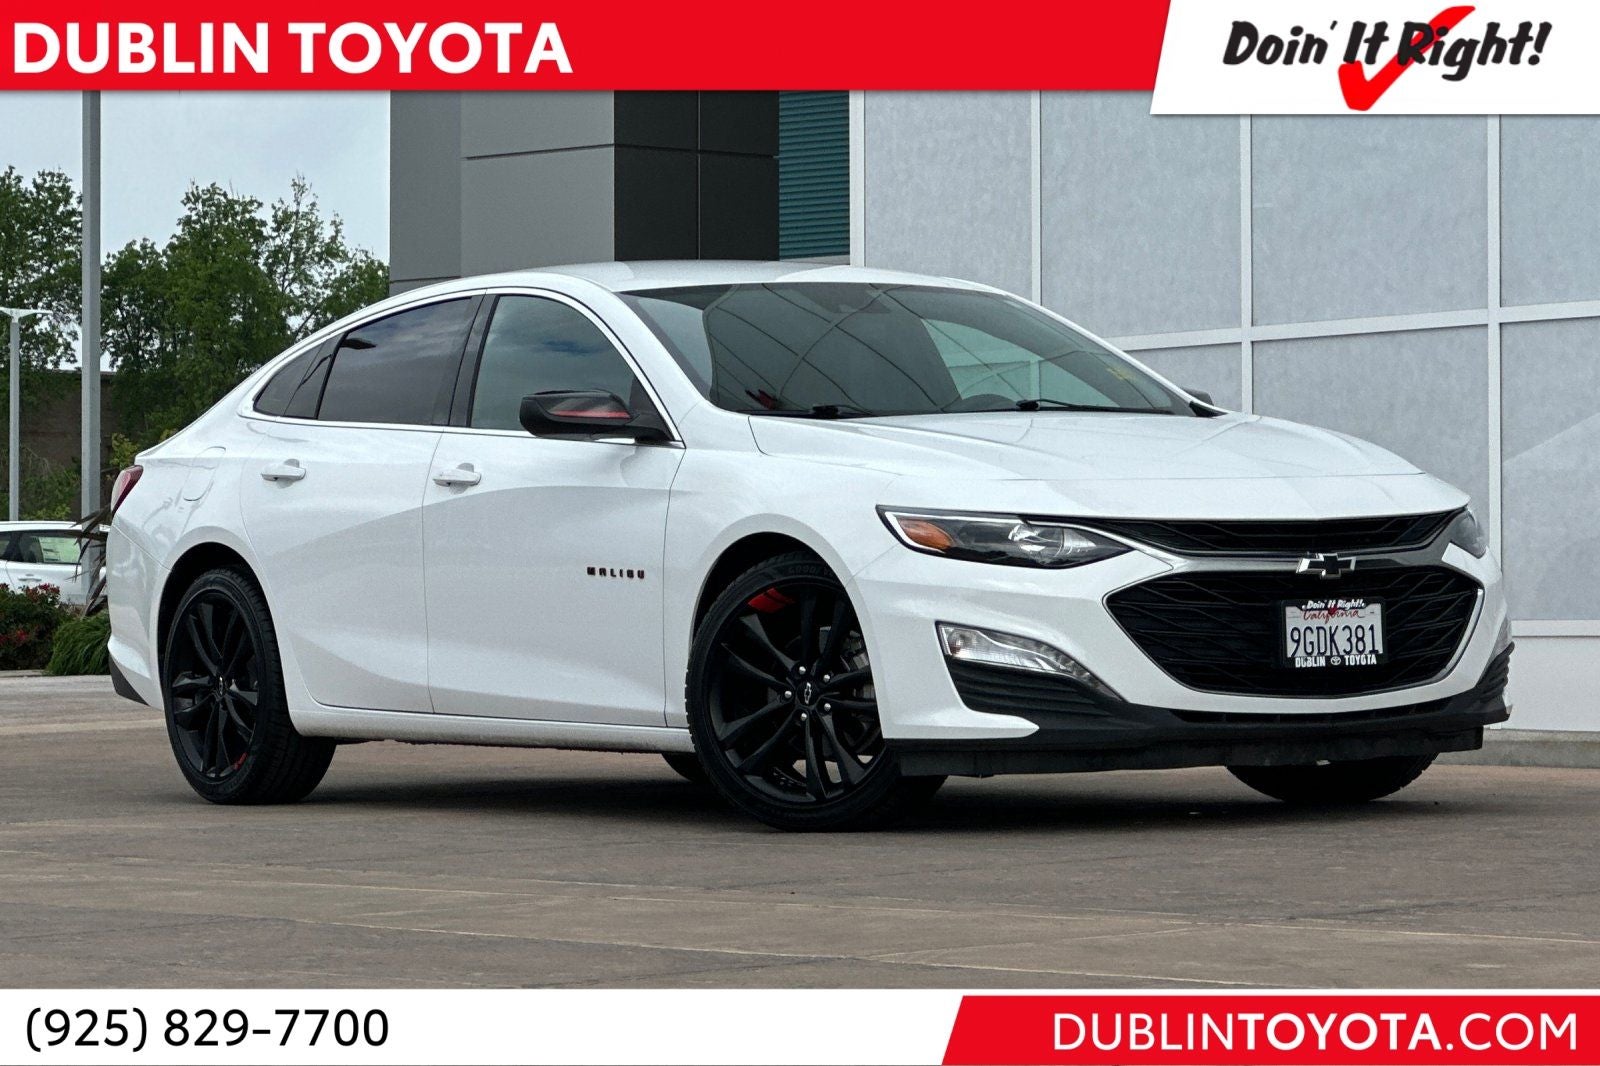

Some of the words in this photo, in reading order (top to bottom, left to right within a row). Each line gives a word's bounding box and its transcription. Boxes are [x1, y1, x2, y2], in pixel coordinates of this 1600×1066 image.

[587, 566, 645, 579] MALIBU
[1290, 624, 1379, 657] 9GDK381
[1295, 656, 1326, 668] DUBLIN
[1344, 654, 1377, 666] TOYOTA
